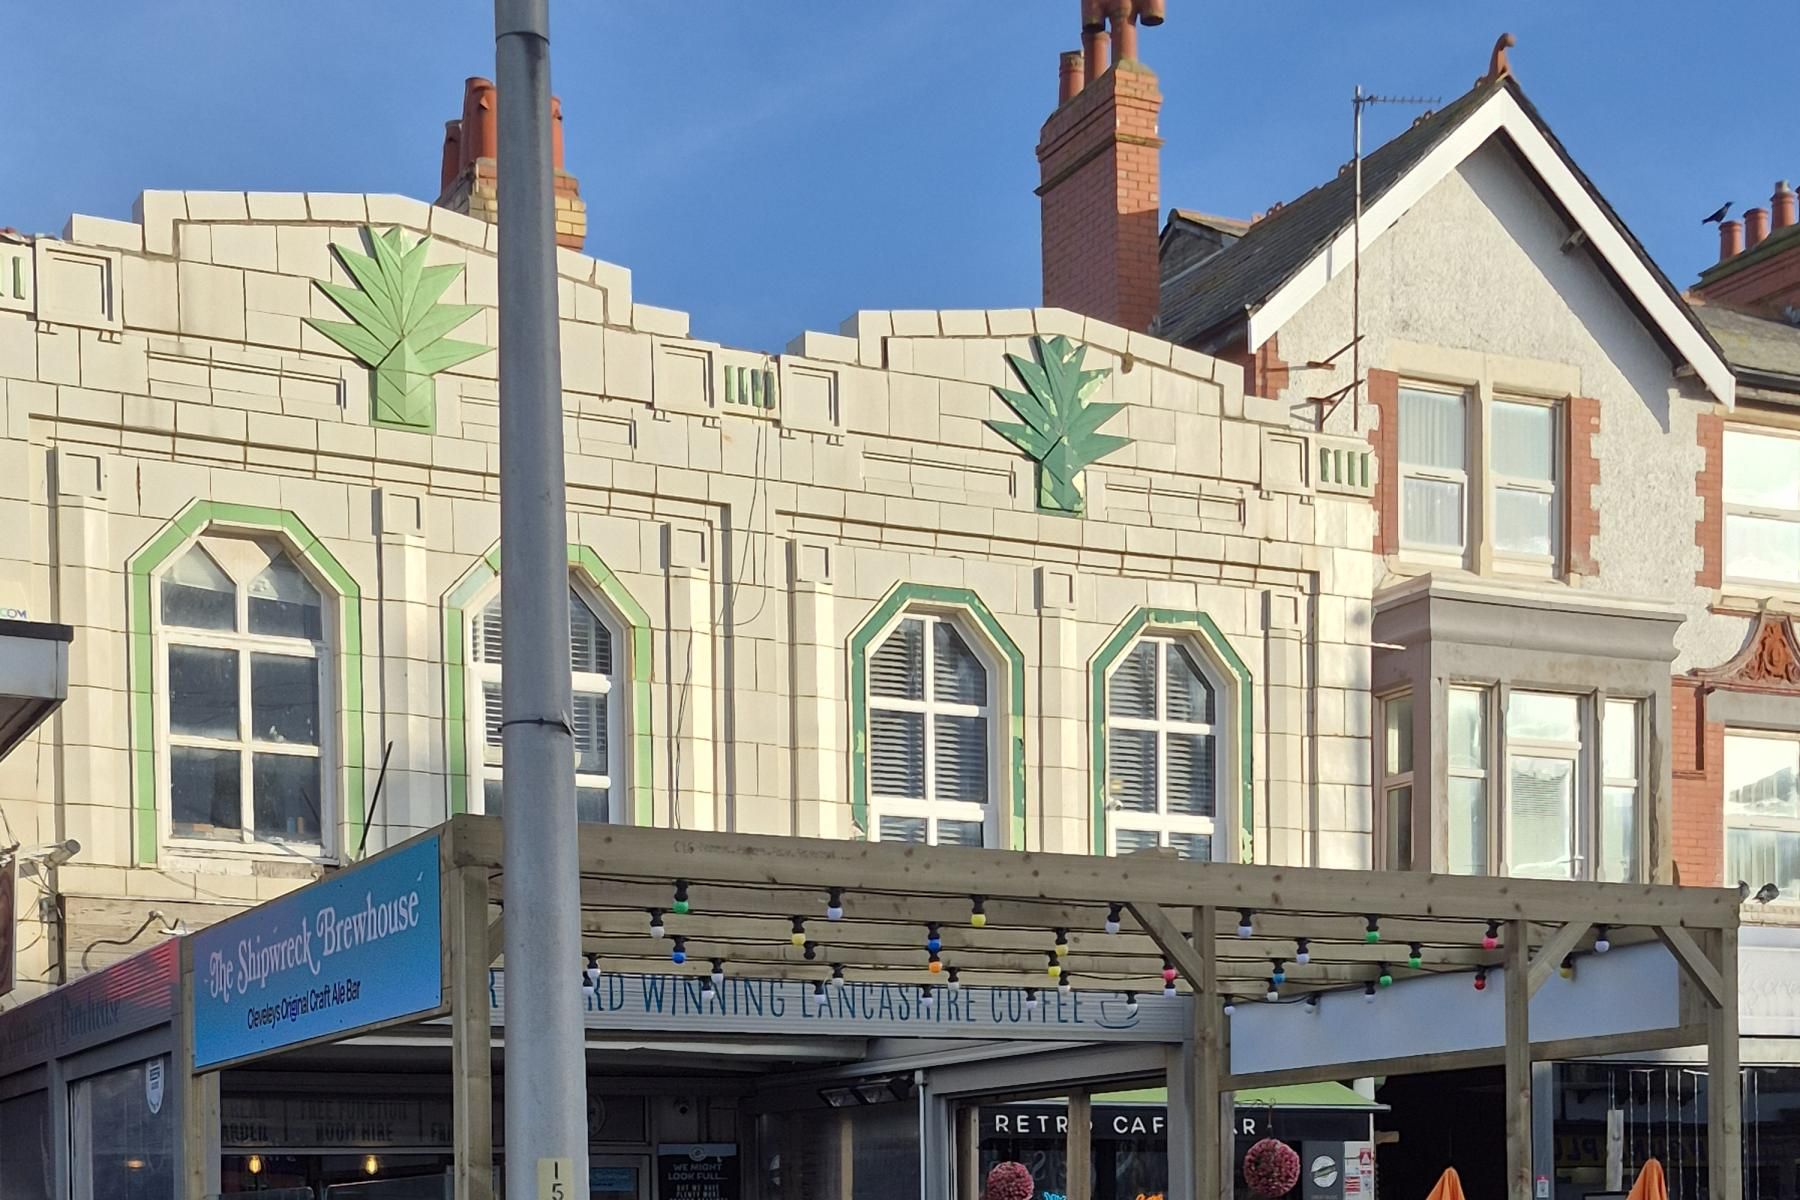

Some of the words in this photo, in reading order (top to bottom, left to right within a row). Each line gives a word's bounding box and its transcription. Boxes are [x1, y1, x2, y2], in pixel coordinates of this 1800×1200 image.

[210, 952, 233, 1002] The
[237, 917, 320, 994] Shipwreck
[316, 891, 419, 957] Brewhouse
[248, 1004, 281, 1030] Cleveleys
[281, 991, 310, 1023] Original
[310, 984, 331, 1012] Craft
[331, 981, 346, 1003] Ale
[346, 978, 361, 1000] Bar
[995, 1114, 1093, 1134] RETR
[1113, 1115, 1168, 1135] CAF
